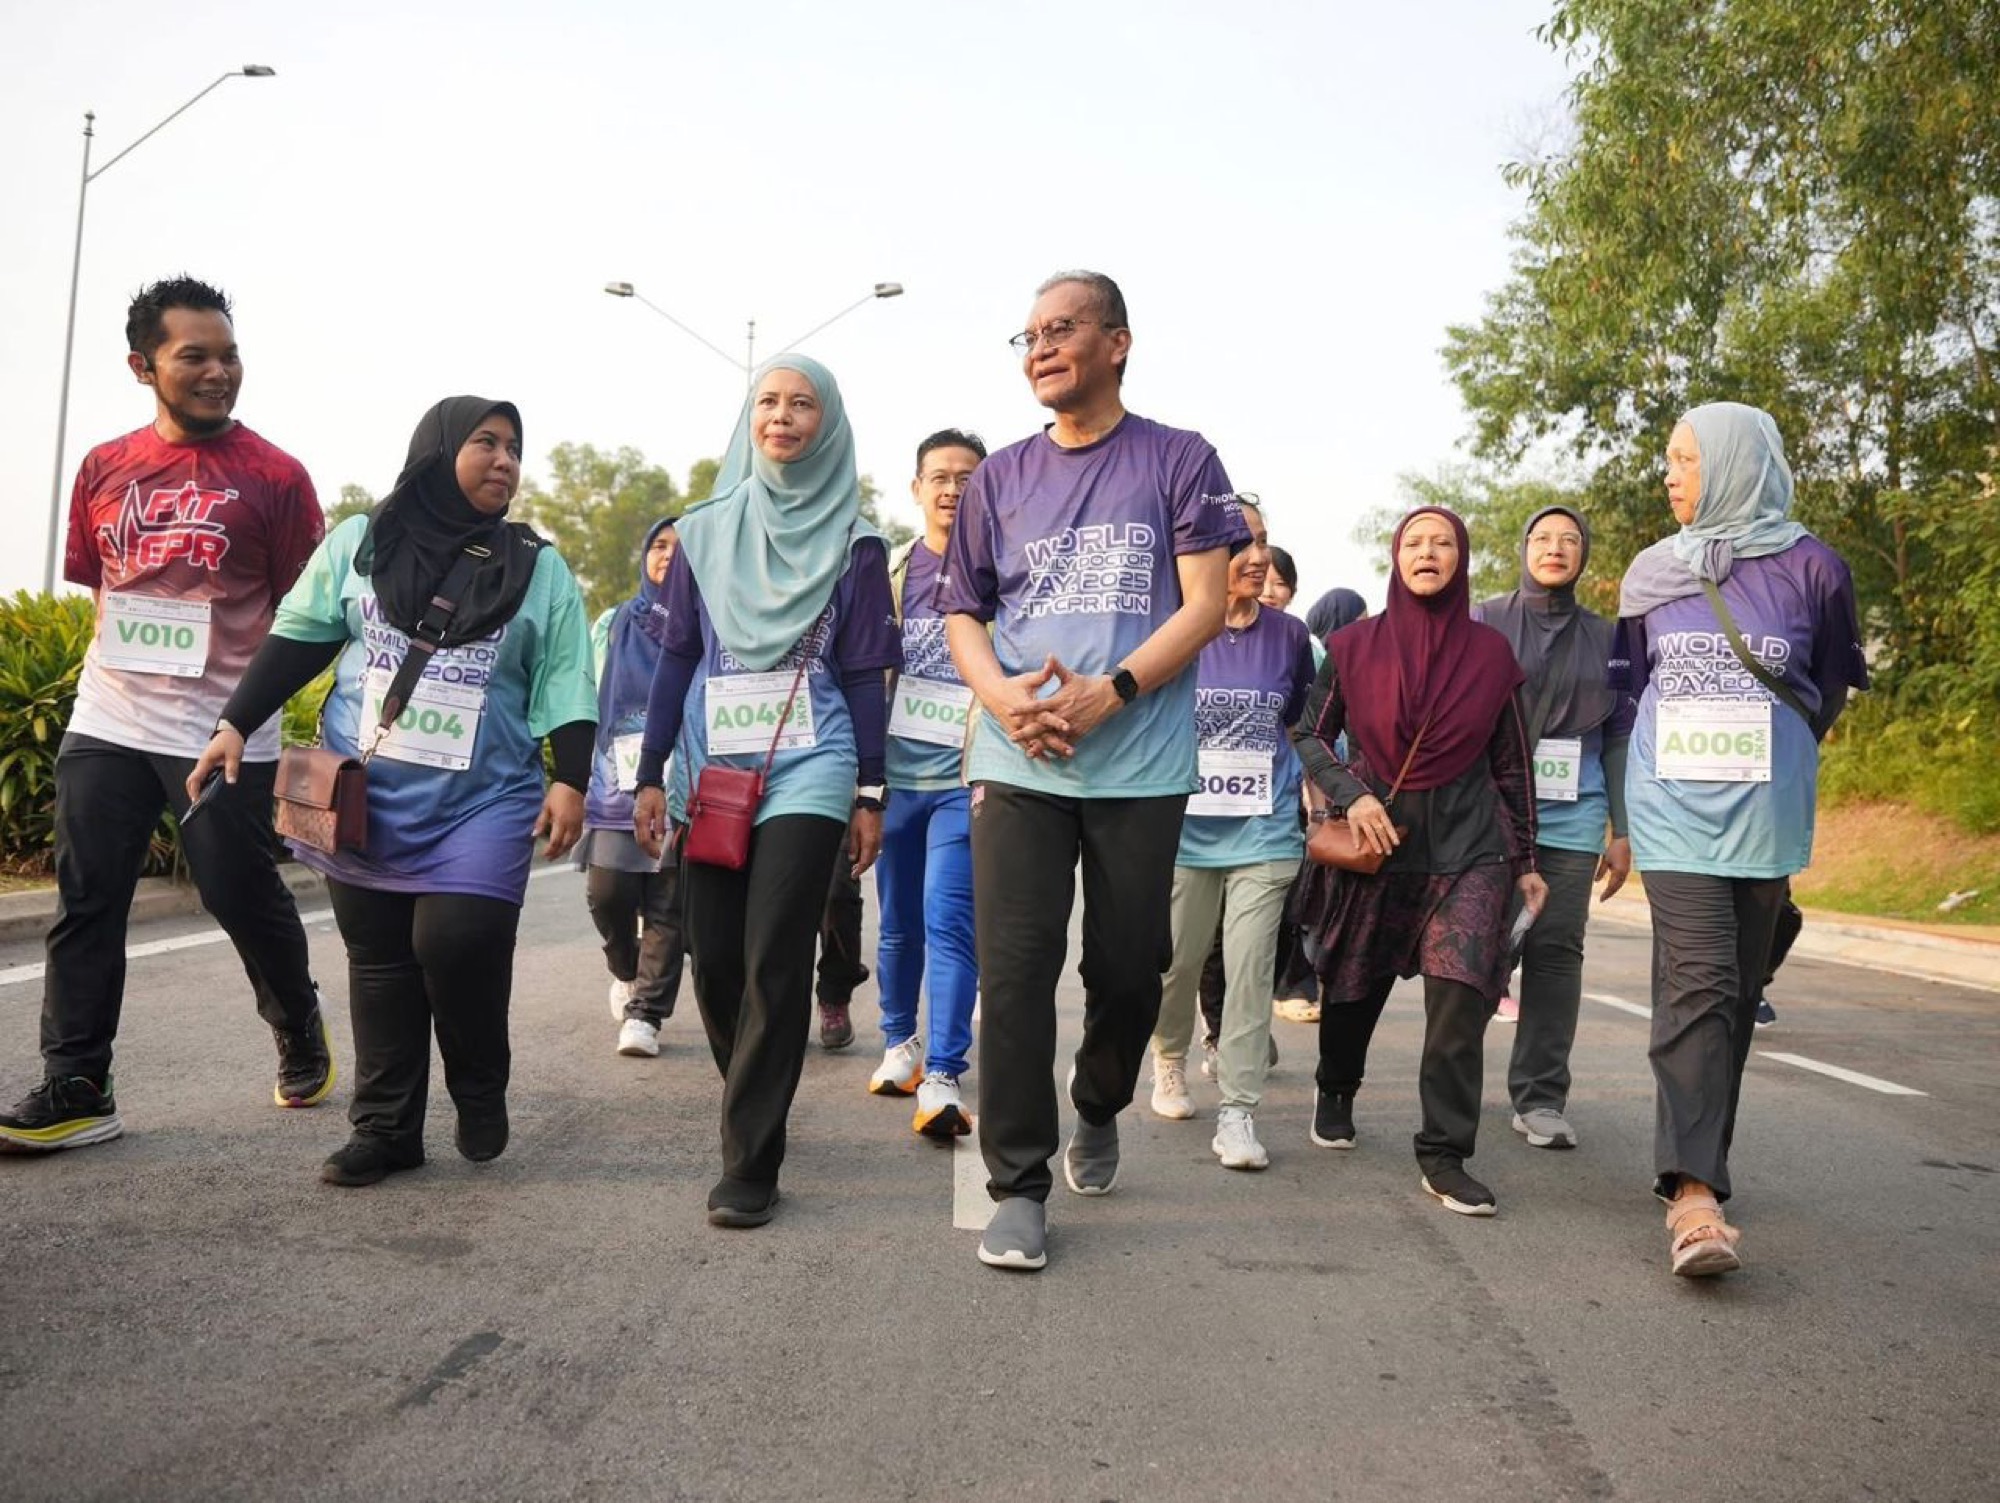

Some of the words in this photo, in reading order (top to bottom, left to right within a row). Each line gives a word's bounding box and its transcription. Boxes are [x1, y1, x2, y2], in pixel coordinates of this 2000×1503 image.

[1025, 523, 1156, 569] WORLD
[1077, 552, 1154, 570] DOCTOR
[1081, 570, 1151, 593] 2025
[1052, 595, 1101, 615] CPR
[1101, 591, 1151, 616] RUN
[117, 619, 195, 649] V010
[1658, 672, 1719, 695] DAY.
[796, 695, 808, 728] 3KM
[904, 696, 968, 727] V002
[1662, 730, 1754, 756] A006
[1755, 729, 1766, 762] 3KM
